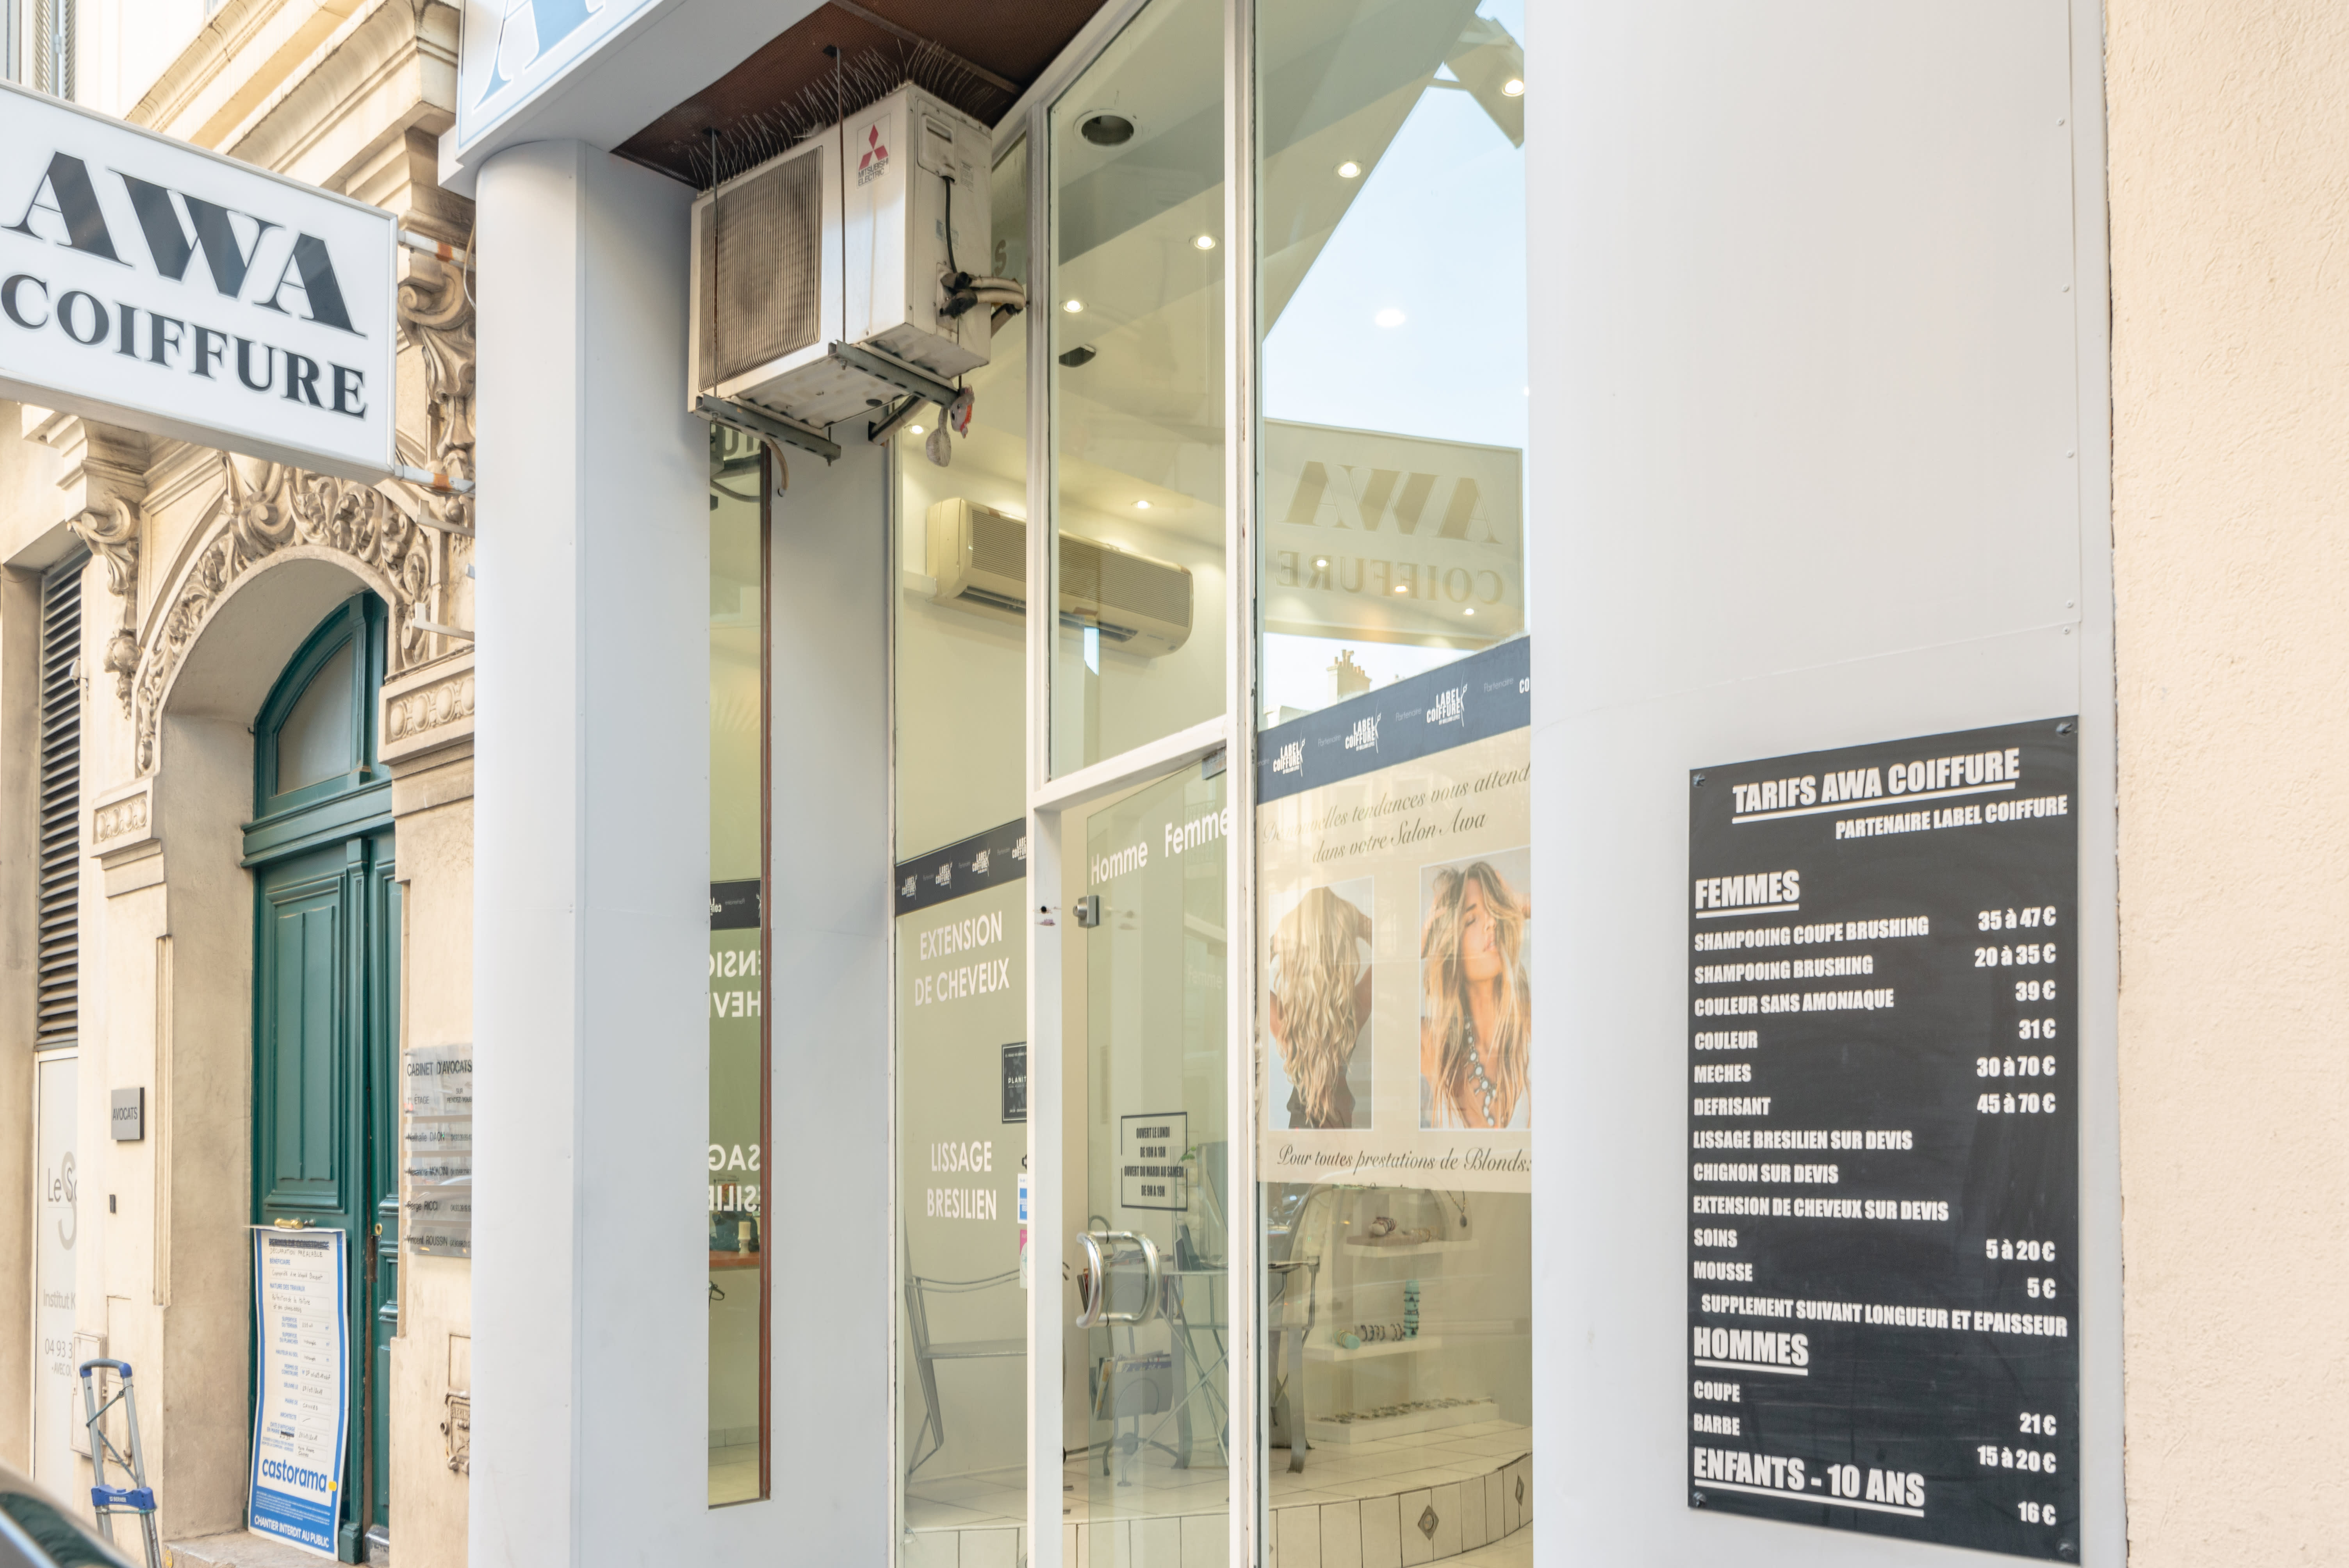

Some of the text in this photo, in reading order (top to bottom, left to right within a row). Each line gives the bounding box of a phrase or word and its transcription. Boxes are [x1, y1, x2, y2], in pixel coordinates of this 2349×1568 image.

[858, 158, 889, 178] MITSUBISHI
[858, 168, 884, 186] ELECTRIC
[2, 151, 367, 338] AWA
[1, 274, 368, 419] COIFFURE
[1436, 687, 1460, 709] LABEL
[1426, 702, 1460, 723] COIFFURE
[1353, 715, 1375, 735] LABEL
[1280, 741, 1299, 758] LABEL
[1345, 729, 1375, 749] COIFFURE
[1273, 754, 1300, 772] COIFFURE
[1732, 748, 2019, 813] TARIFS AWA COIFFURE
[1352, 793, 1426, 823] tendances
[1431, 780, 1469, 804] vous
[1836, 795, 2067, 839] PARTENAIRE LABEL COIFFURE
[1312, 807, 1486, 864] dans votre Salon Awa
[1091, 841, 1148, 886] Homme
[1695, 870, 1800, 909] FEMMES
[2005, 907, 2017, 929] à
[920, 911, 1002, 961] EXTENSION
[1695, 916, 1929, 951] SHAMPOOING COUPE BRUSHING
[2001, 944, 2012, 966] à
[1695, 955, 1873, 984] SHAMPOOING BRUSHING
[915, 956, 1010, 1006] DE CHEVEUX
[1695, 989, 1894, 1016] COULEUR SANS AMONIAQUE
[1695, 1030, 1758, 1050] COULEUR
[407, 1059, 472, 1077] CABINET D'AVOCATS
[1694, 1064, 1751, 1083] MECHES
[2003, 1056, 2015, 1076] à
[415, 1094, 430, 1105] ÉTAGE
[1694, 1097, 1771, 1115] DEFRISANT
[2003, 1092, 2015, 1113] à
[112, 1107, 138, 1121] AVOCATS
[1136, 1126, 1170, 1139] OUVERT LE LUNDI
[1693, 1130, 1912, 1149] LISSAGE BRESILIEN SUR DEVIS
[931, 1141, 992, 1172] LISSAGE
[1140, 1147, 1145, 1158] DE
[1154, 1146, 1157, 1158] A
[1277, 1144, 1312, 1166] Pour
[1315, 1151, 1353, 1167] toutes
[1353, 1150, 1436, 1175] prestations
[1440, 1147, 1458, 1170] de
[1125, 1165, 1184, 1178] OUVERT DU MARDI AU SAMEDI
[1694, 1163, 1838, 1183] CHIGNON SUR DEVIS
[48, 1167, 62, 1203] Le
[1141, 1185, 1165, 1197] DE 9H A 19H
[424, 1200, 438, 1211] RICCI
[927, 1188, 996, 1221] BRESILIEN
[1693, 1196, 1949, 1221] EXTENSION DE CHEVEUX SUR DEVIS
[426, 1236, 447, 1247] ROUSSIN
[1694, 1228, 1737, 1247] SOINS
[2001, 1239, 2013, 1260] à
[1694, 1261, 1752, 1281] MOUSSE
[44, 1289, 70, 1309] Institut
[1702, 1294, 2067, 1337] SUPPLEMENT SUIVANT LONGUEUR ET EPAISSEUR
[45, 1338, 54, 1356] 04
[57, 1340, 66, 1358] 93
[1694, 1326, 1809, 1366] HOMMES
[1694, 1381, 1740, 1402] COUPE
[1694, 1413, 1740, 1436] BARBE
[2001, 1447, 2013, 1468] à
[262, 1459, 327, 1493] castorama
[1694, 1447, 1804, 1490] ENFANTS
[1866, 1468, 1925, 1507] ANS
[255, 1514, 330, 1548] CHANTIER INTERDIT AU PUBLIC
